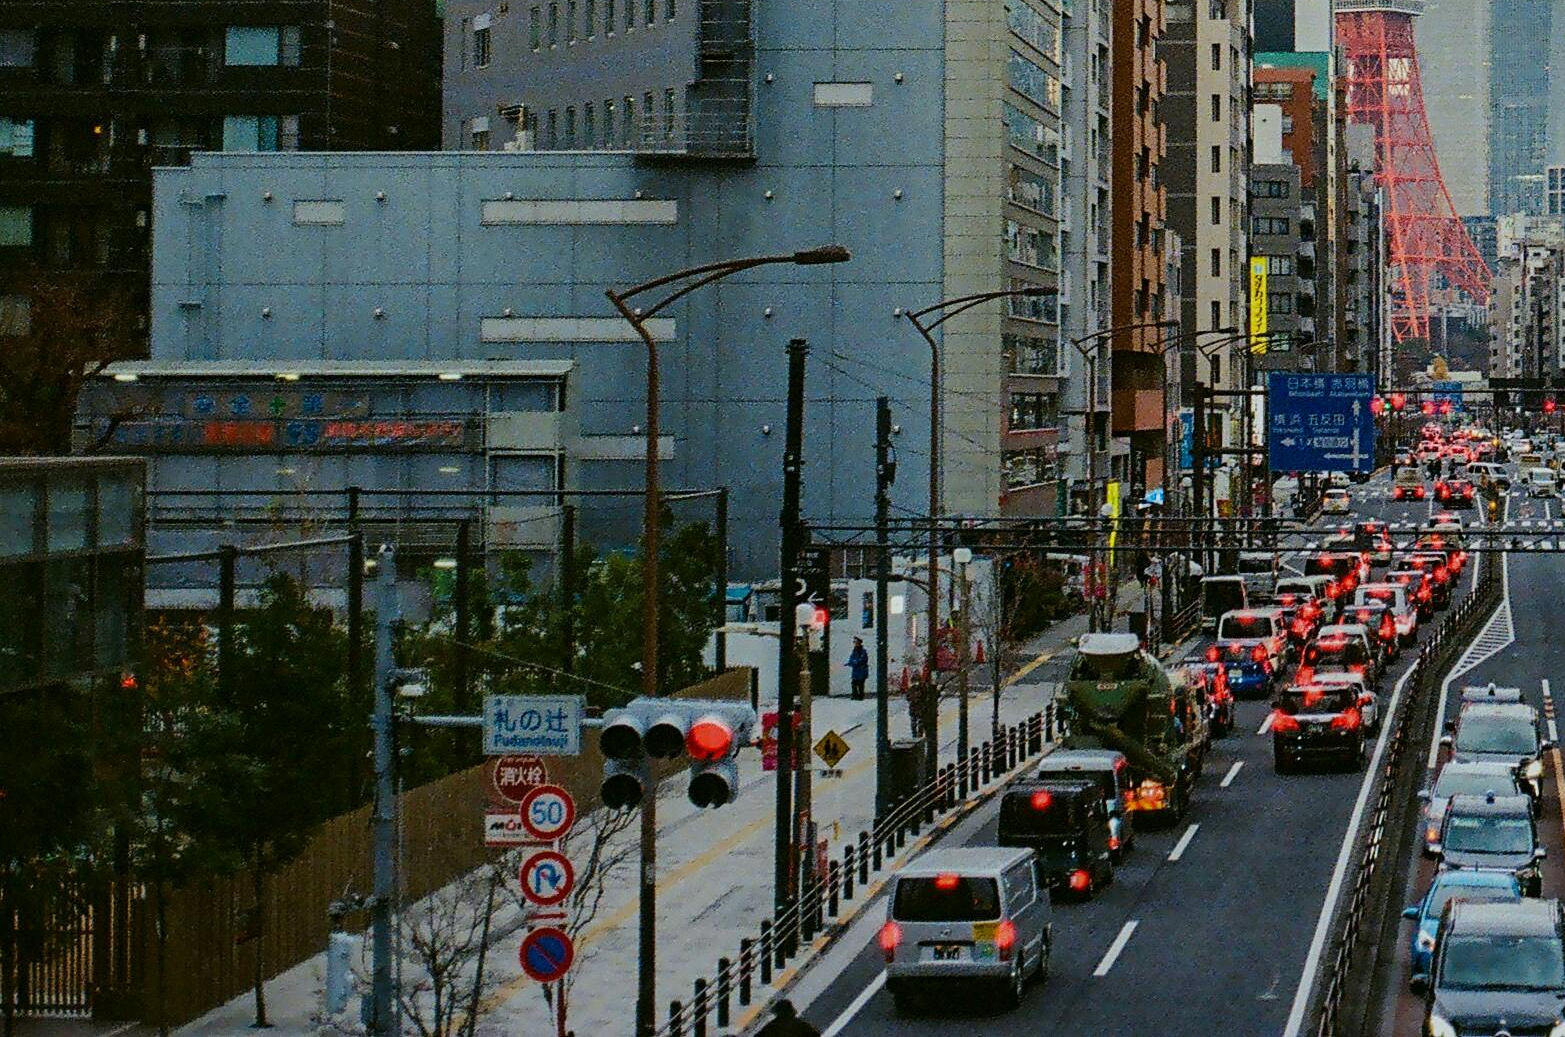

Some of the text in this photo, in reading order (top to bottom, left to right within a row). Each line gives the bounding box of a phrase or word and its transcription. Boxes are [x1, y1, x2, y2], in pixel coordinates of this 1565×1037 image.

[1308, 413, 1345, 426] 五反田
[494, 706, 569, 732] 札の辻
[500, 766, 543, 787] 消火栓
[531, 800, 563, 825] 50
